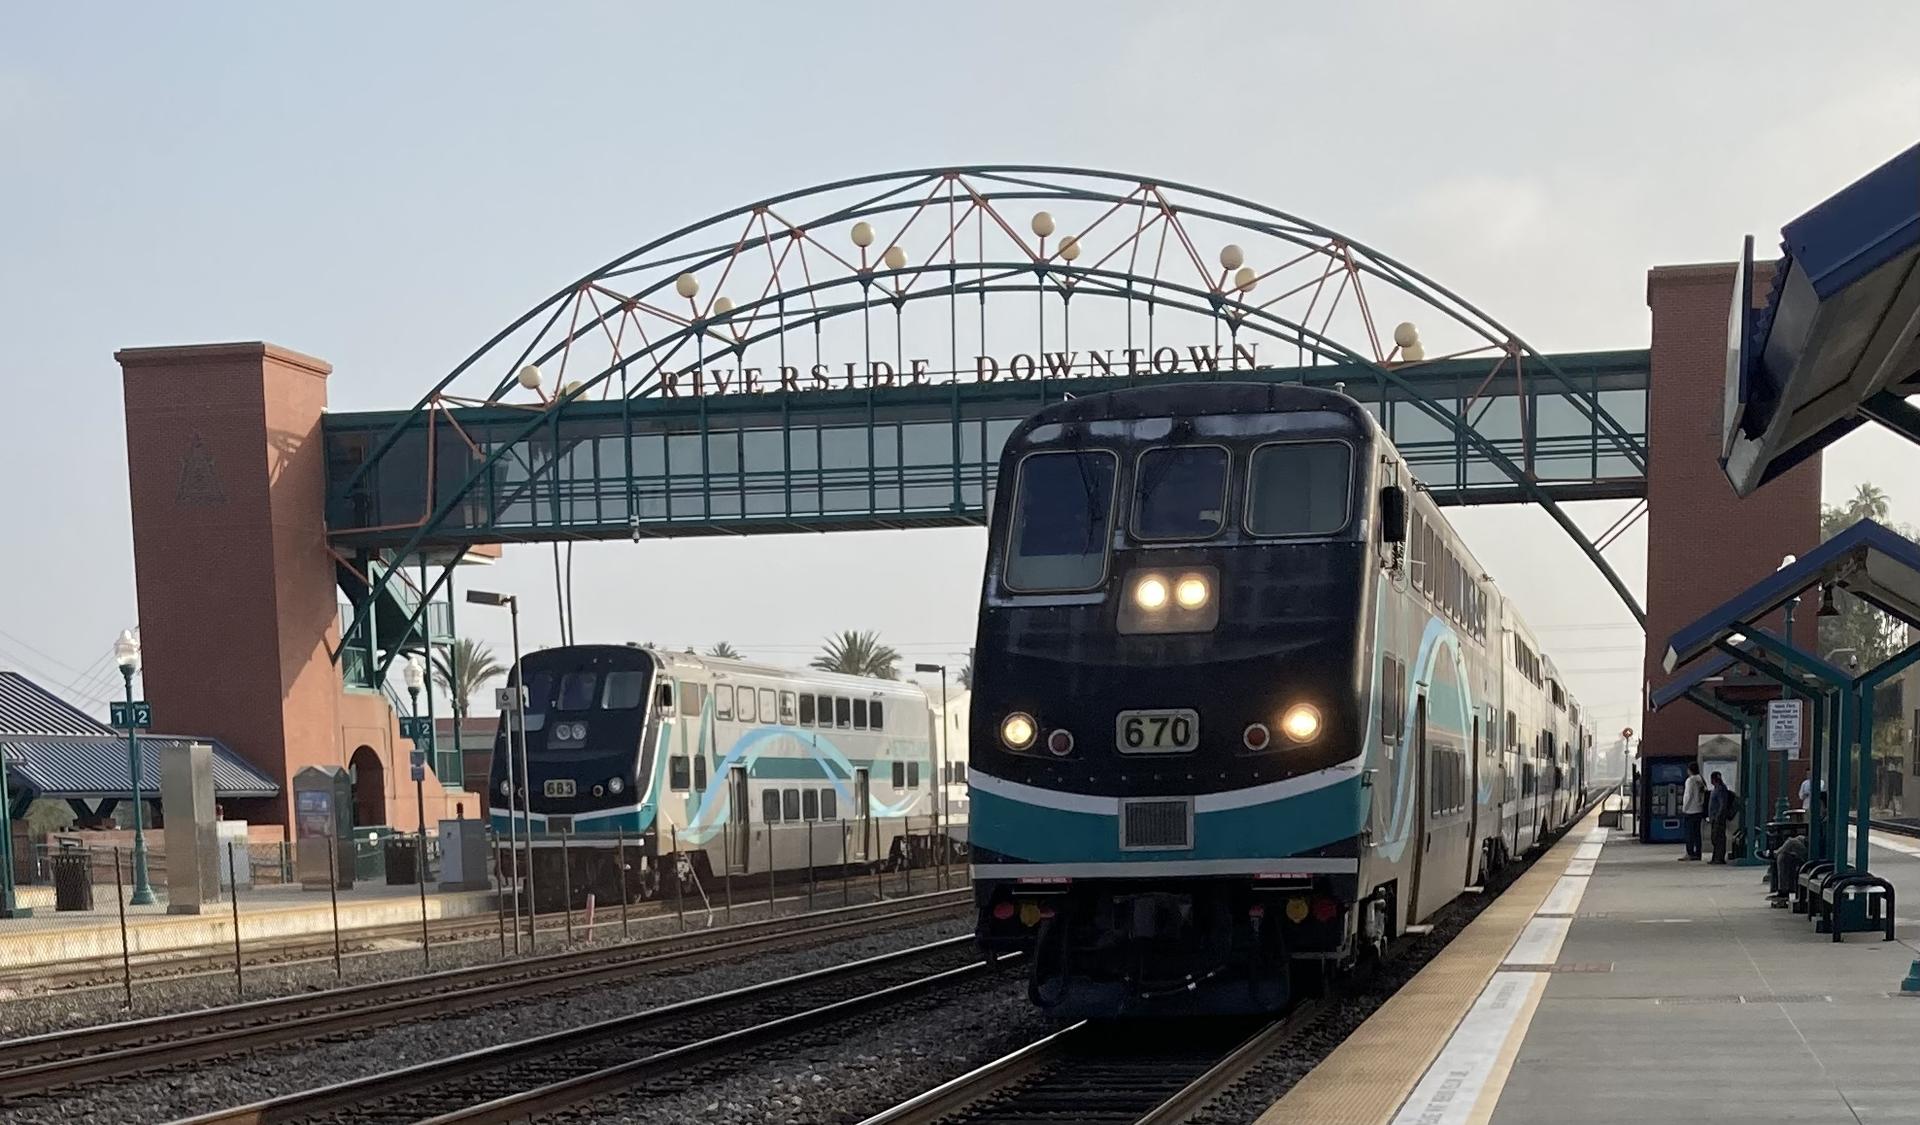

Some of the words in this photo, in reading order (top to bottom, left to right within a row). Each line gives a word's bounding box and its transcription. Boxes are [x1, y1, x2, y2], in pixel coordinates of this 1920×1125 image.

[660, 359, 932, 398] RIVERSIDE
[974, 343, 1259, 384] DOWNTOWN
[501, 691, 509, 701] 6
[116, 711, 123, 724] 1
[138, 710, 148, 723] 2
[422, 723, 430, 735] 2
[1125, 717, 1190, 747] 670
